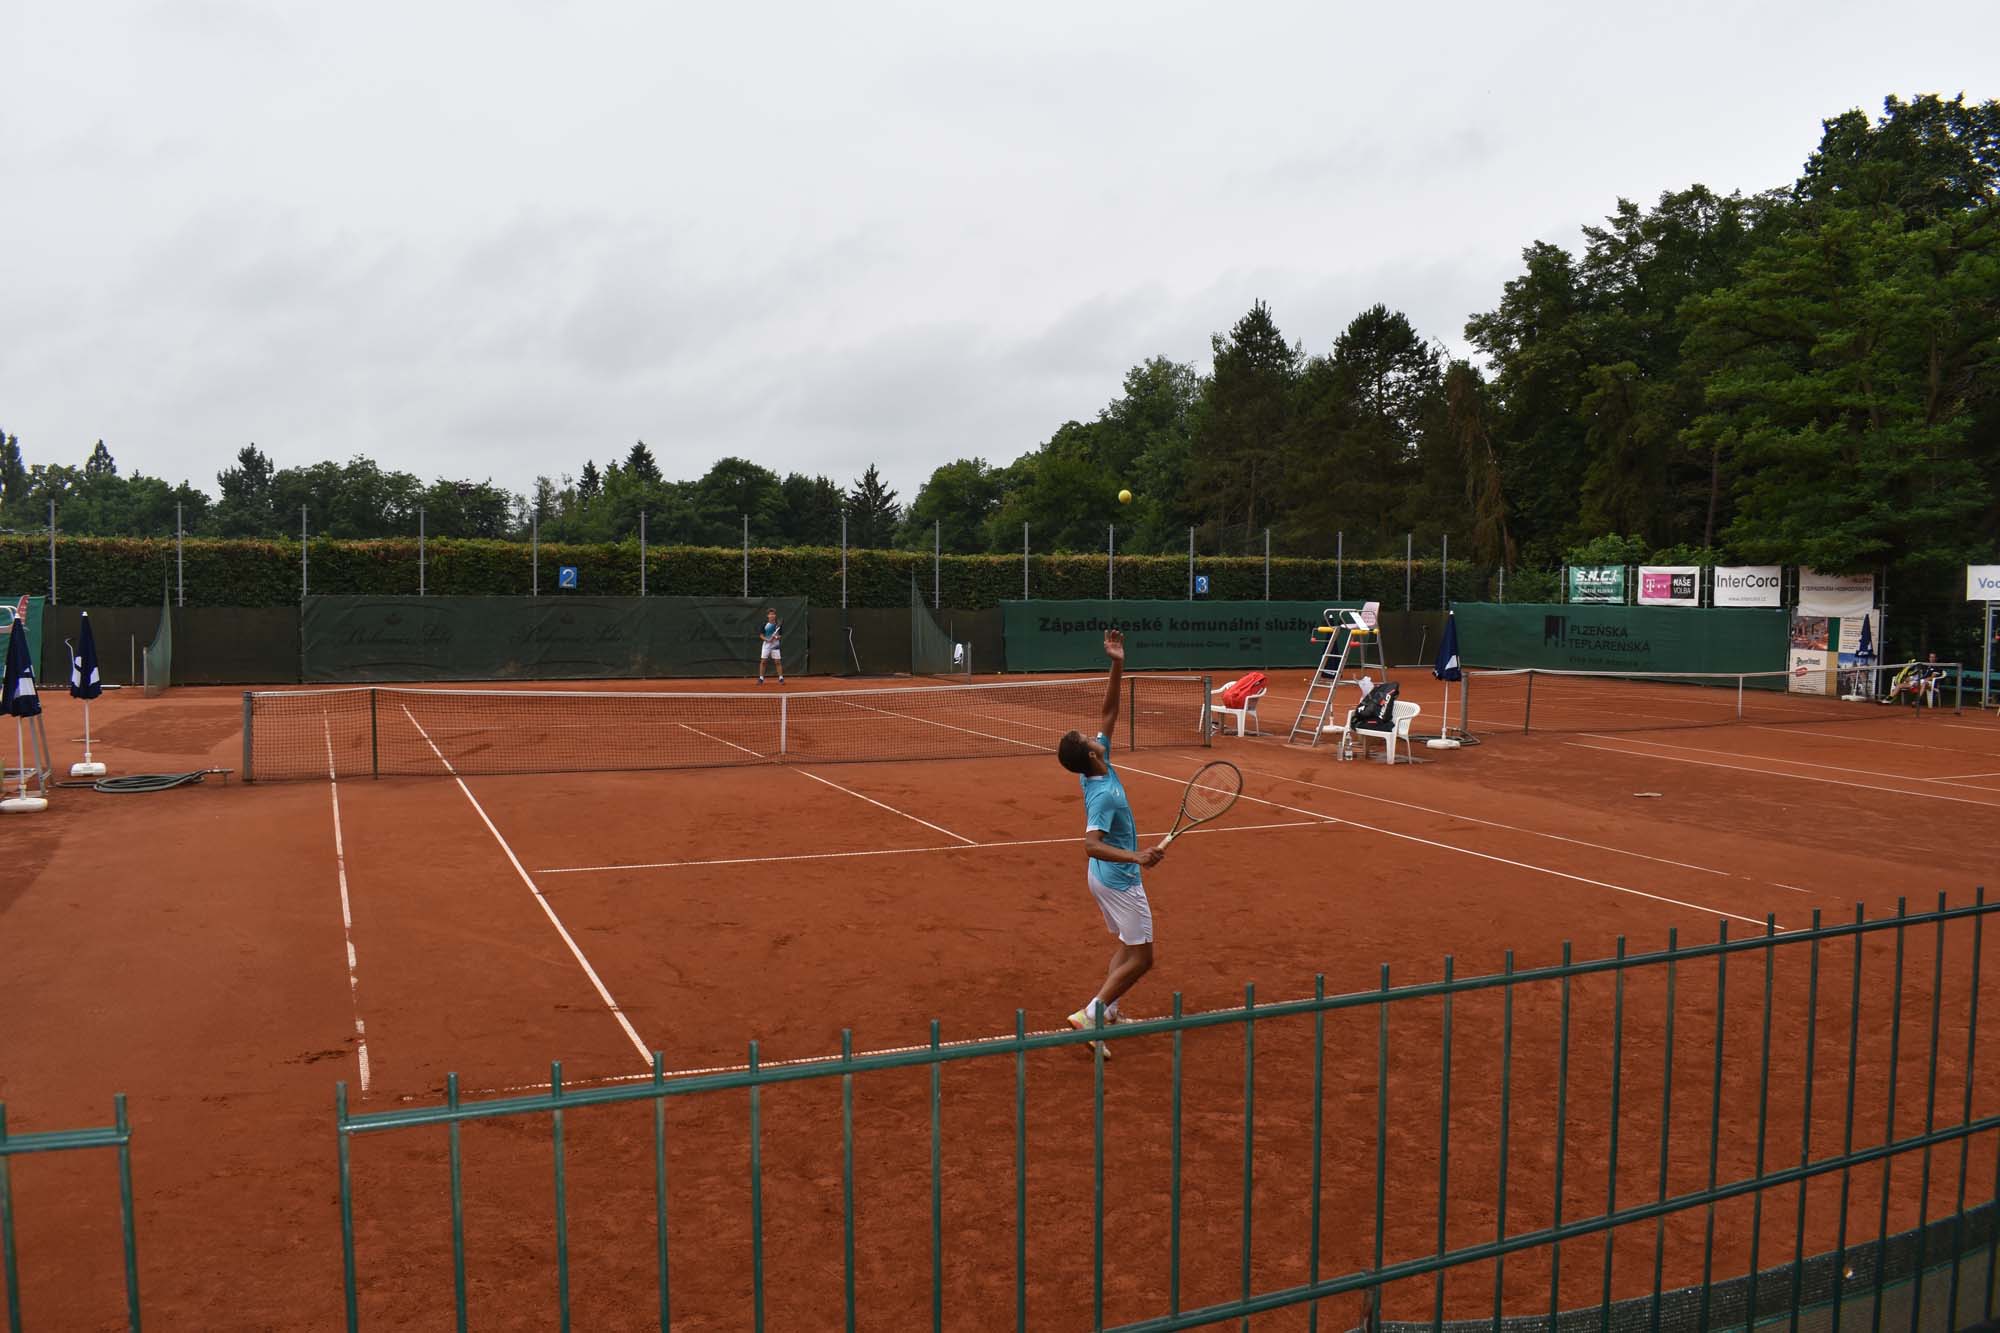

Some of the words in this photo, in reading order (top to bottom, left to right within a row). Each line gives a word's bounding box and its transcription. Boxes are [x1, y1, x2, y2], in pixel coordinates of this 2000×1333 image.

[562, 568, 575, 587] 2
[1198, 576, 1207, 592] 3
[1716, 574, 1779, 588] InterCora
[1039, 616, 1162, 636] Západočeské
[1168, 616, 1260, 632] komunální
[1264, 616, 1317, 635] služby
